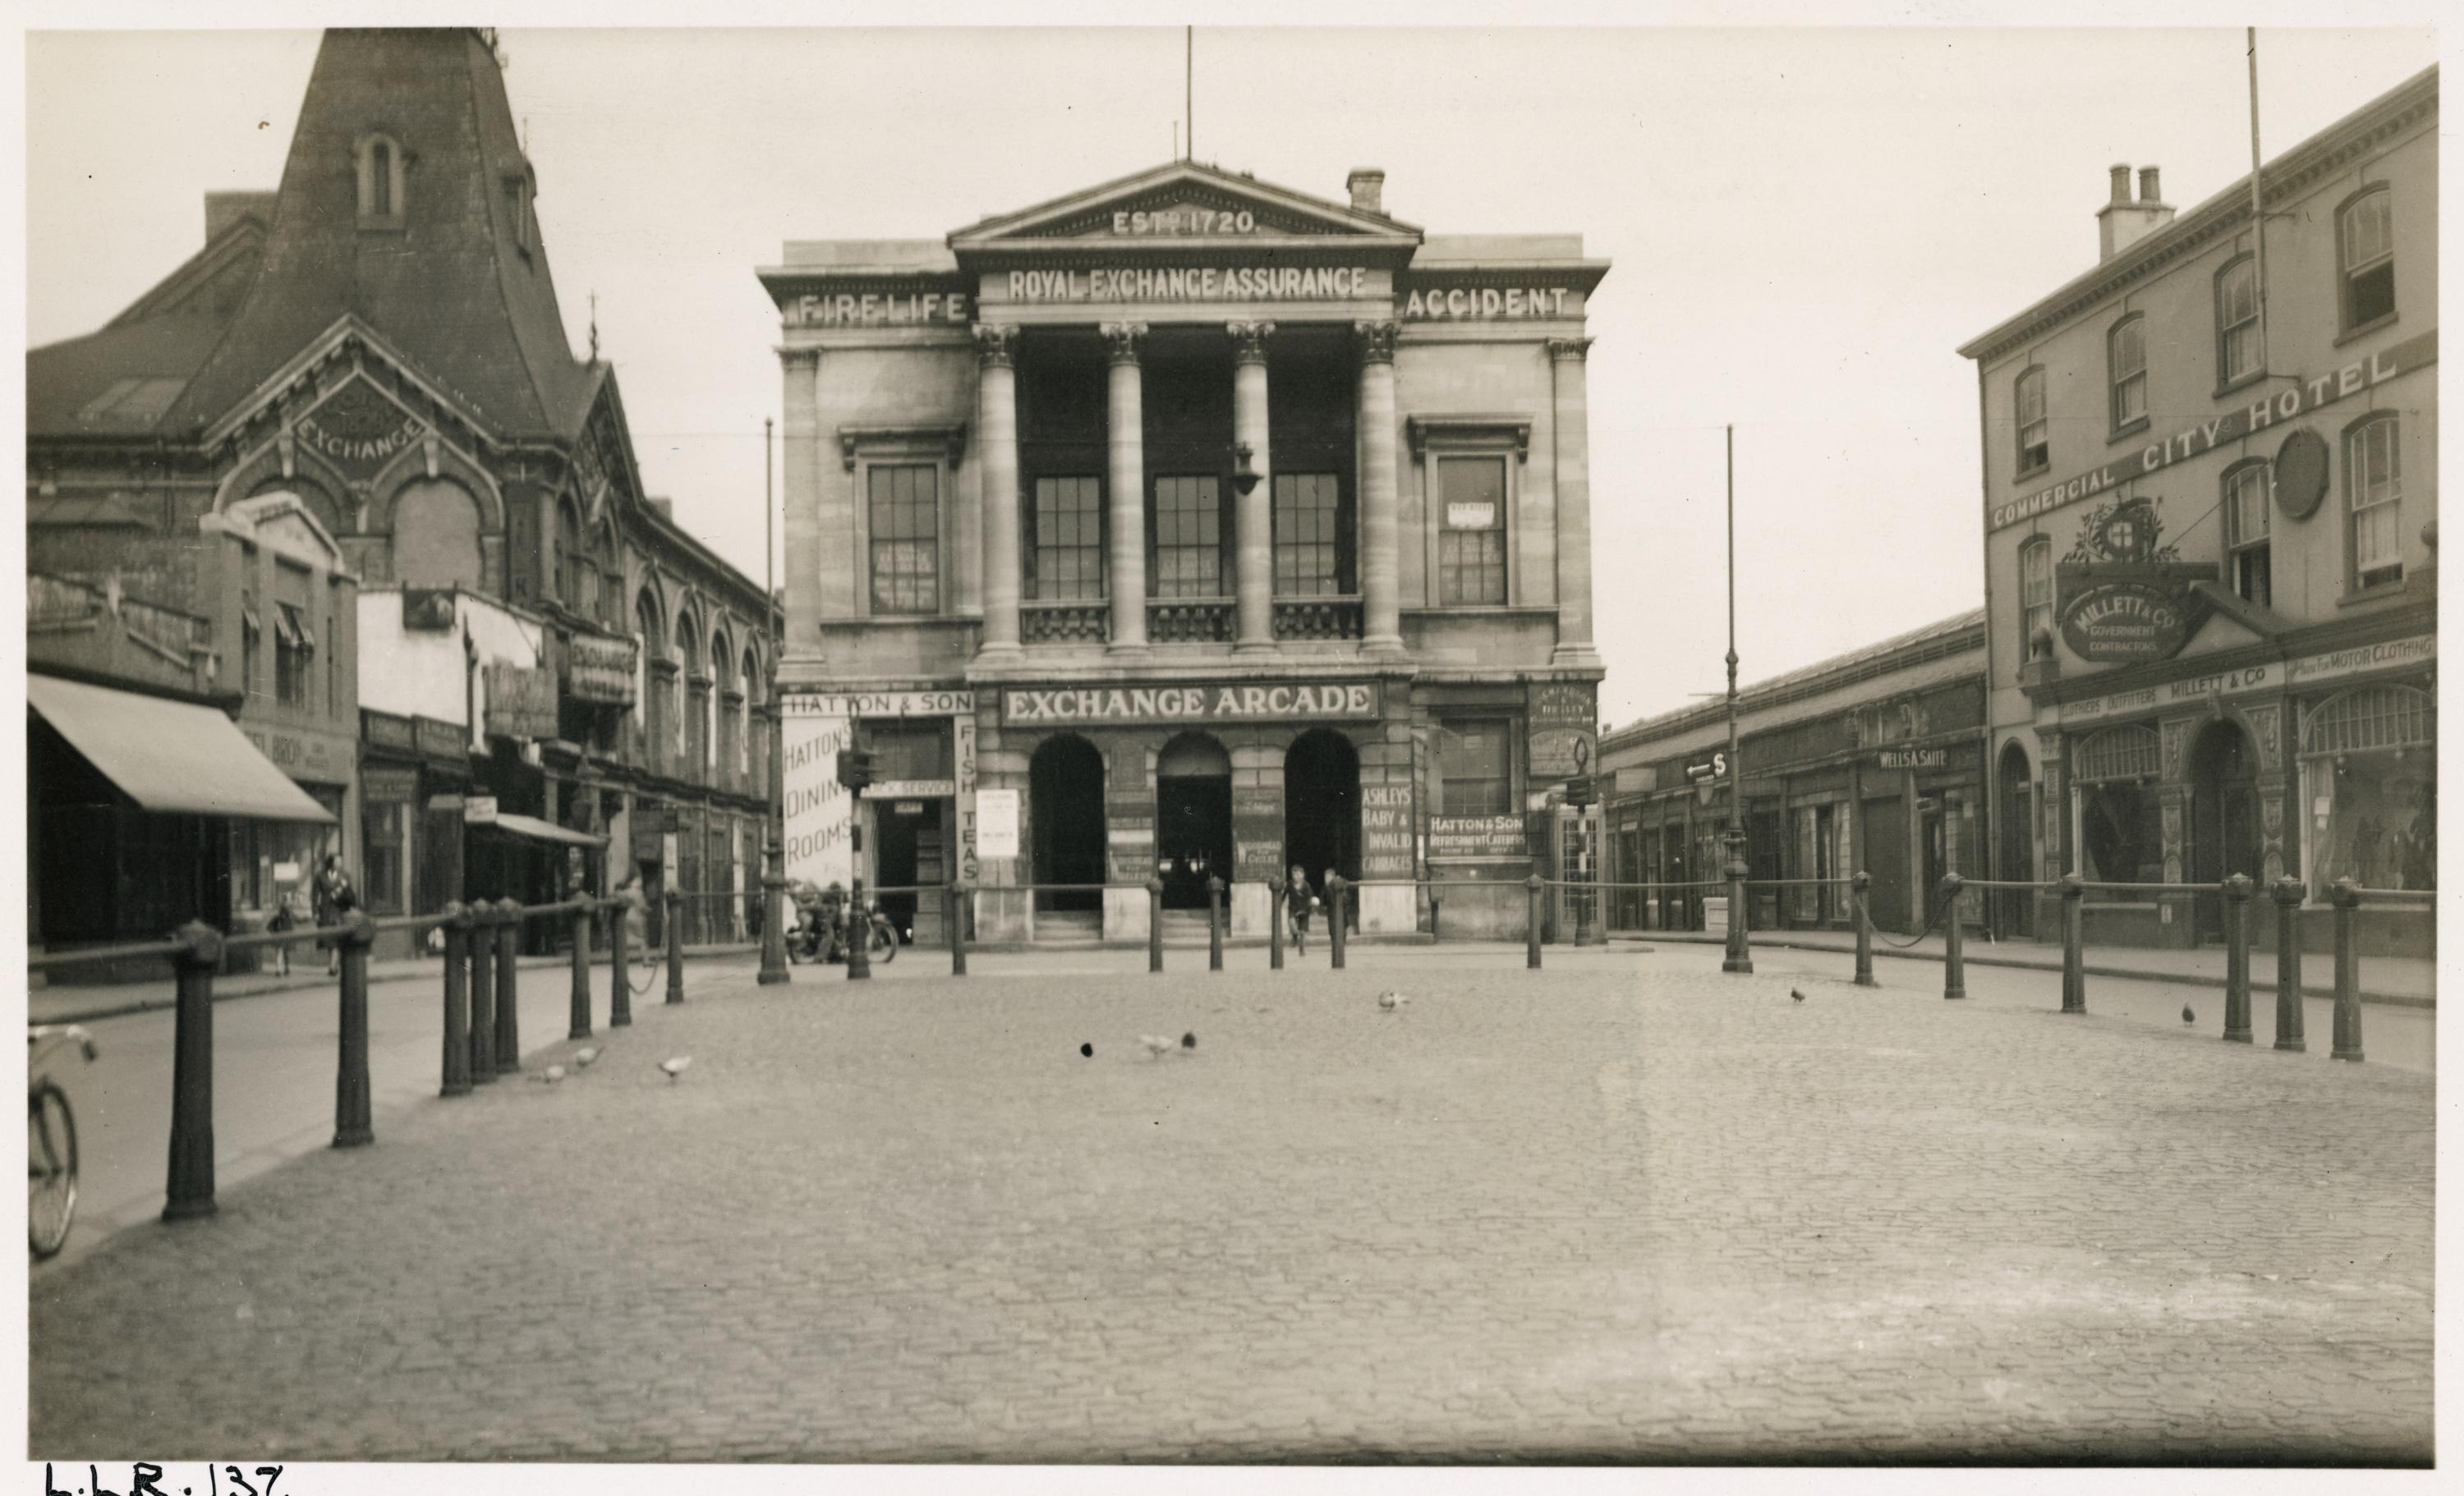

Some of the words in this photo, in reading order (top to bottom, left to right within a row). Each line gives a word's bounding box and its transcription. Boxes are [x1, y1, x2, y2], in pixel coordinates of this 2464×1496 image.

[1009, 269, 1085, 299] ROYAL
[1089, 268, 1216, 299] EXCHANGE
[1221, 267, 1366, 297] ASSURANCE
[798, 293, 880, 324] FIRE
[888, 291, 968, 321] LIFE
[1405, 287, 1567, 317] ACCIDENT
[297, 417, 426, 459] EXCHANGE
[1993, 466, 2115, 525] COMMERCIAL
[2143, 419, 2220, 471] CITY
[2248, 354, 2397, 430] HOTEL
[2075, 596, 2145, 633] MILLETT
[2089, 625, 2155, 636] GOVERNMENT
[2089, 640, 2157, 651] CONTRACTORS
[2330, 649, 2370, 669] MOTOR
[2372, 637, 2432, 662] CLOTHING
[791, 695, 890, 714] HATTON
[901, 695, 911, 711] &
[921, 693, 972, 711] SON
[1007, 686, 1204, 720] EXCHANGE
[1213, 685, 1370, 715] ARCADE
[2107, 688, 2156, 713] OUTFITTERS
[2170, 676, 2224, 699] MILLETT
[2228, 673, 2240, 689] &
[960, 725, 976, 793] FISH
[1879, 750, 1910, 769] WELLS
[903, 782, 954, 795] SERVICE
[1363, 808, 1395, 827] BABY
[1399, 812, 1408, 826] &
[1431, 816, 1484, 832] HATTON
[1486, 818, 1494, 829] &
[1495, 815, 1524, 830] SON
[788, 815, 853, 865] ROOMS
[962, 810, 977, 880] TEAS
[1368, 831, 1413, 850] INVALID
